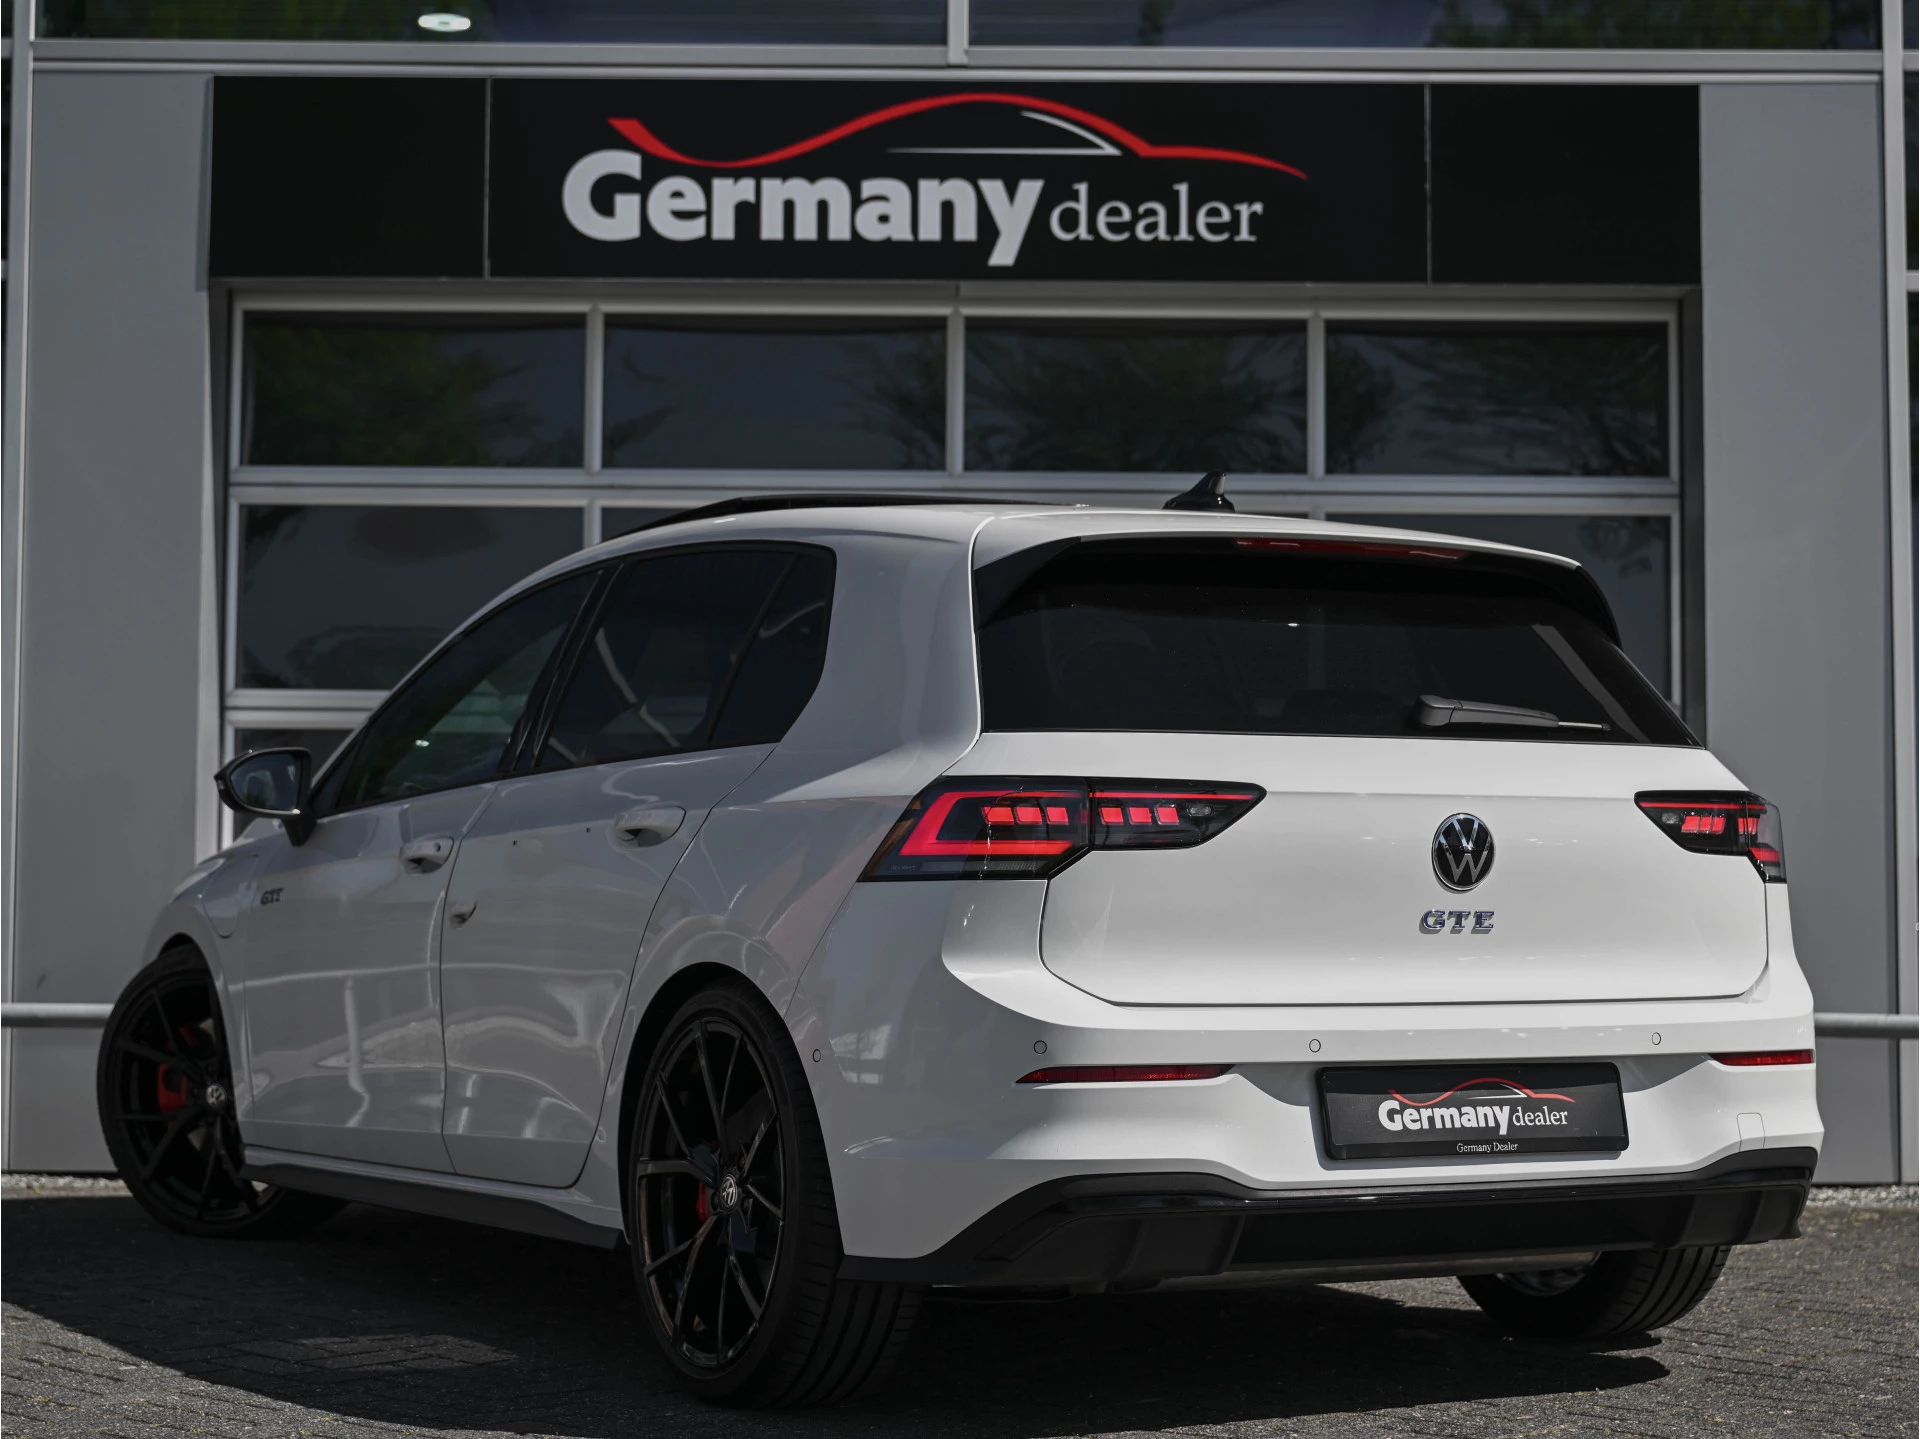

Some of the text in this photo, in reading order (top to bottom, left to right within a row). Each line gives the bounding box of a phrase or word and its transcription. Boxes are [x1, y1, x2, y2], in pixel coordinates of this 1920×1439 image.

[562, 150, 1263, 266] Germany dealer
[1421, 910, 1495, 931] GTE
[1378, 1100, 1568, 1135] Germany dealer
[1456, 1141, 1519, 1153] Germany Dealer
